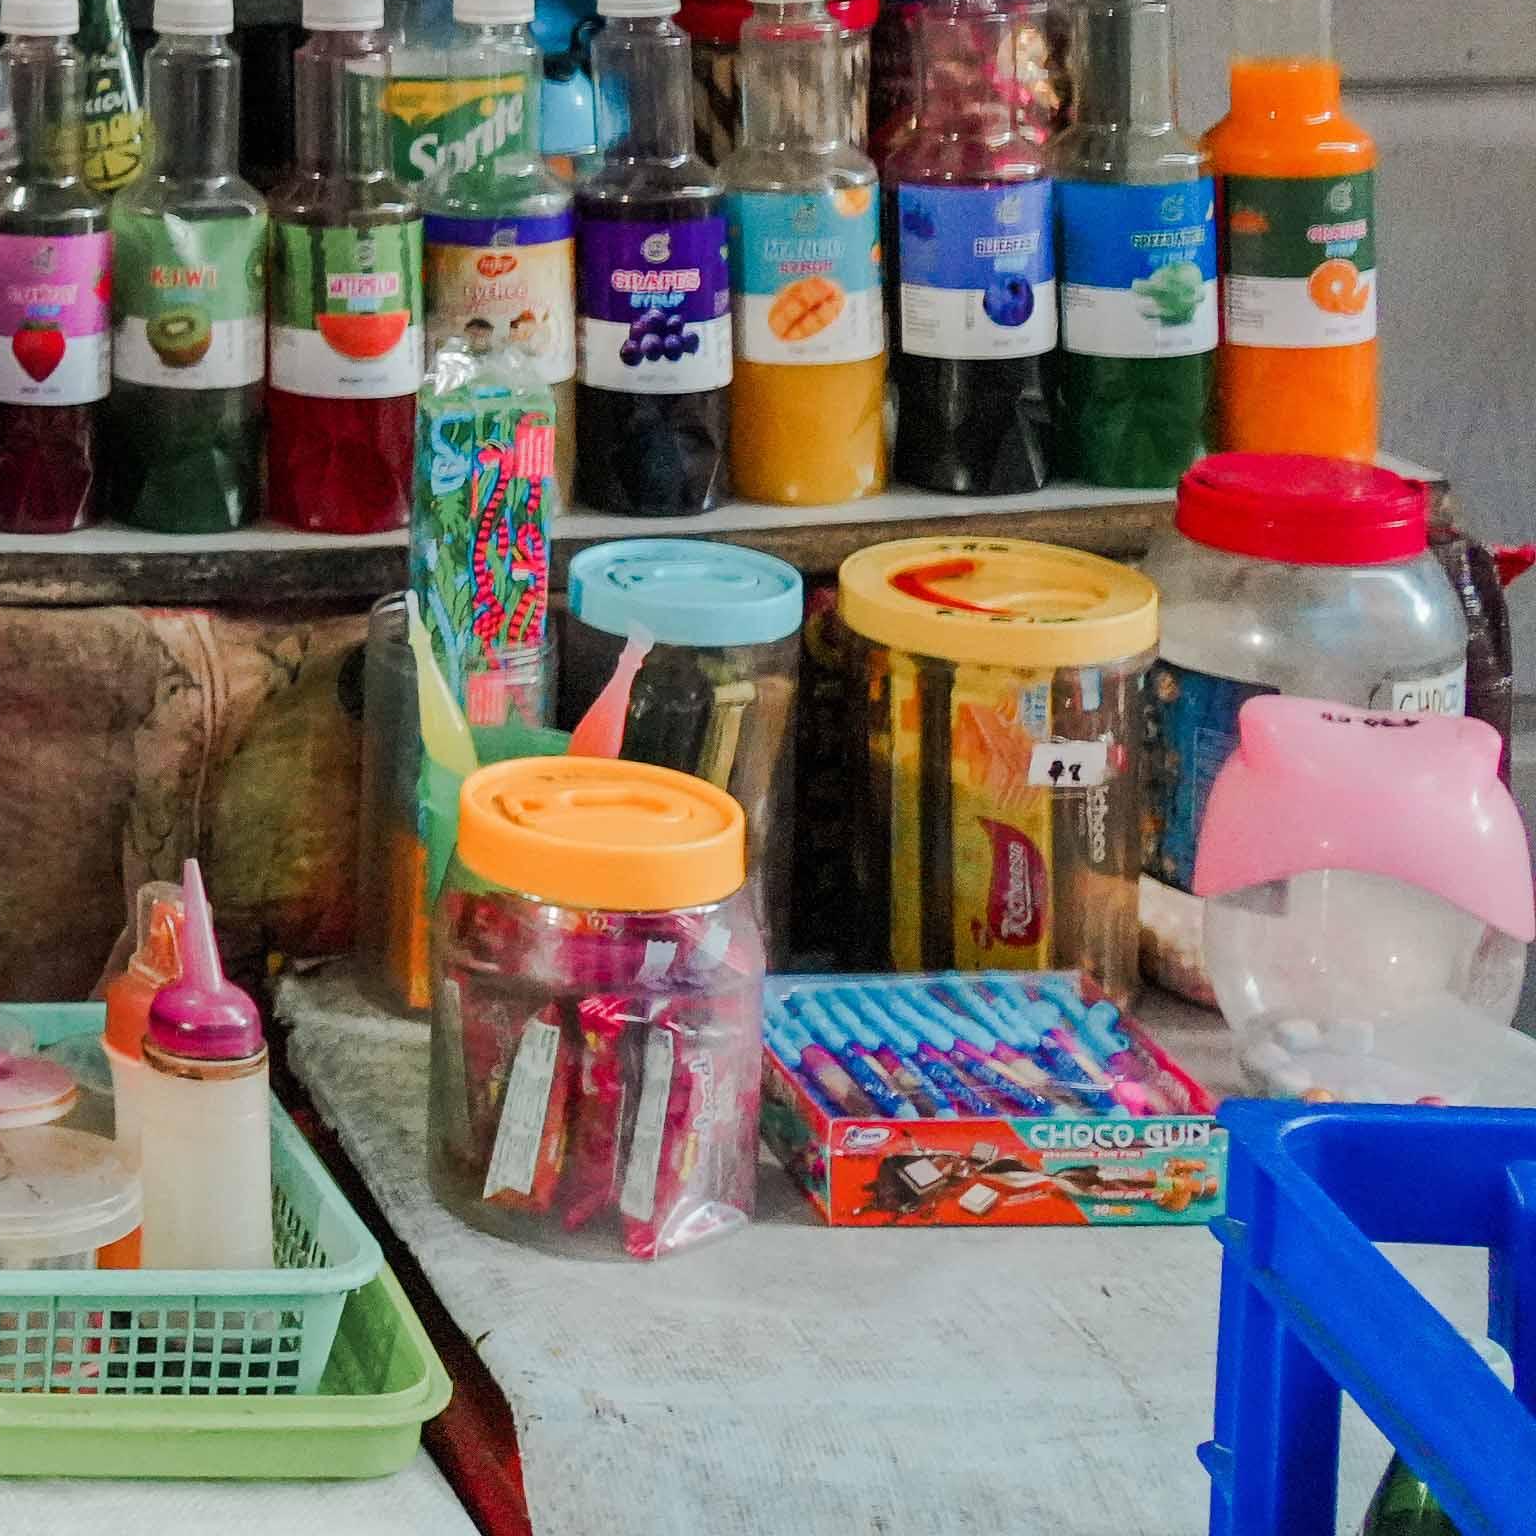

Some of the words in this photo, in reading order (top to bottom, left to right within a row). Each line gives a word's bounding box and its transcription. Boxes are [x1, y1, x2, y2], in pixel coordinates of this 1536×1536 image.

[409, 93, 524, 185] Sprite
[1029, 1123, 1136, 1149] CHOCO
[1144, 1123, 1212, 1148] GUN
